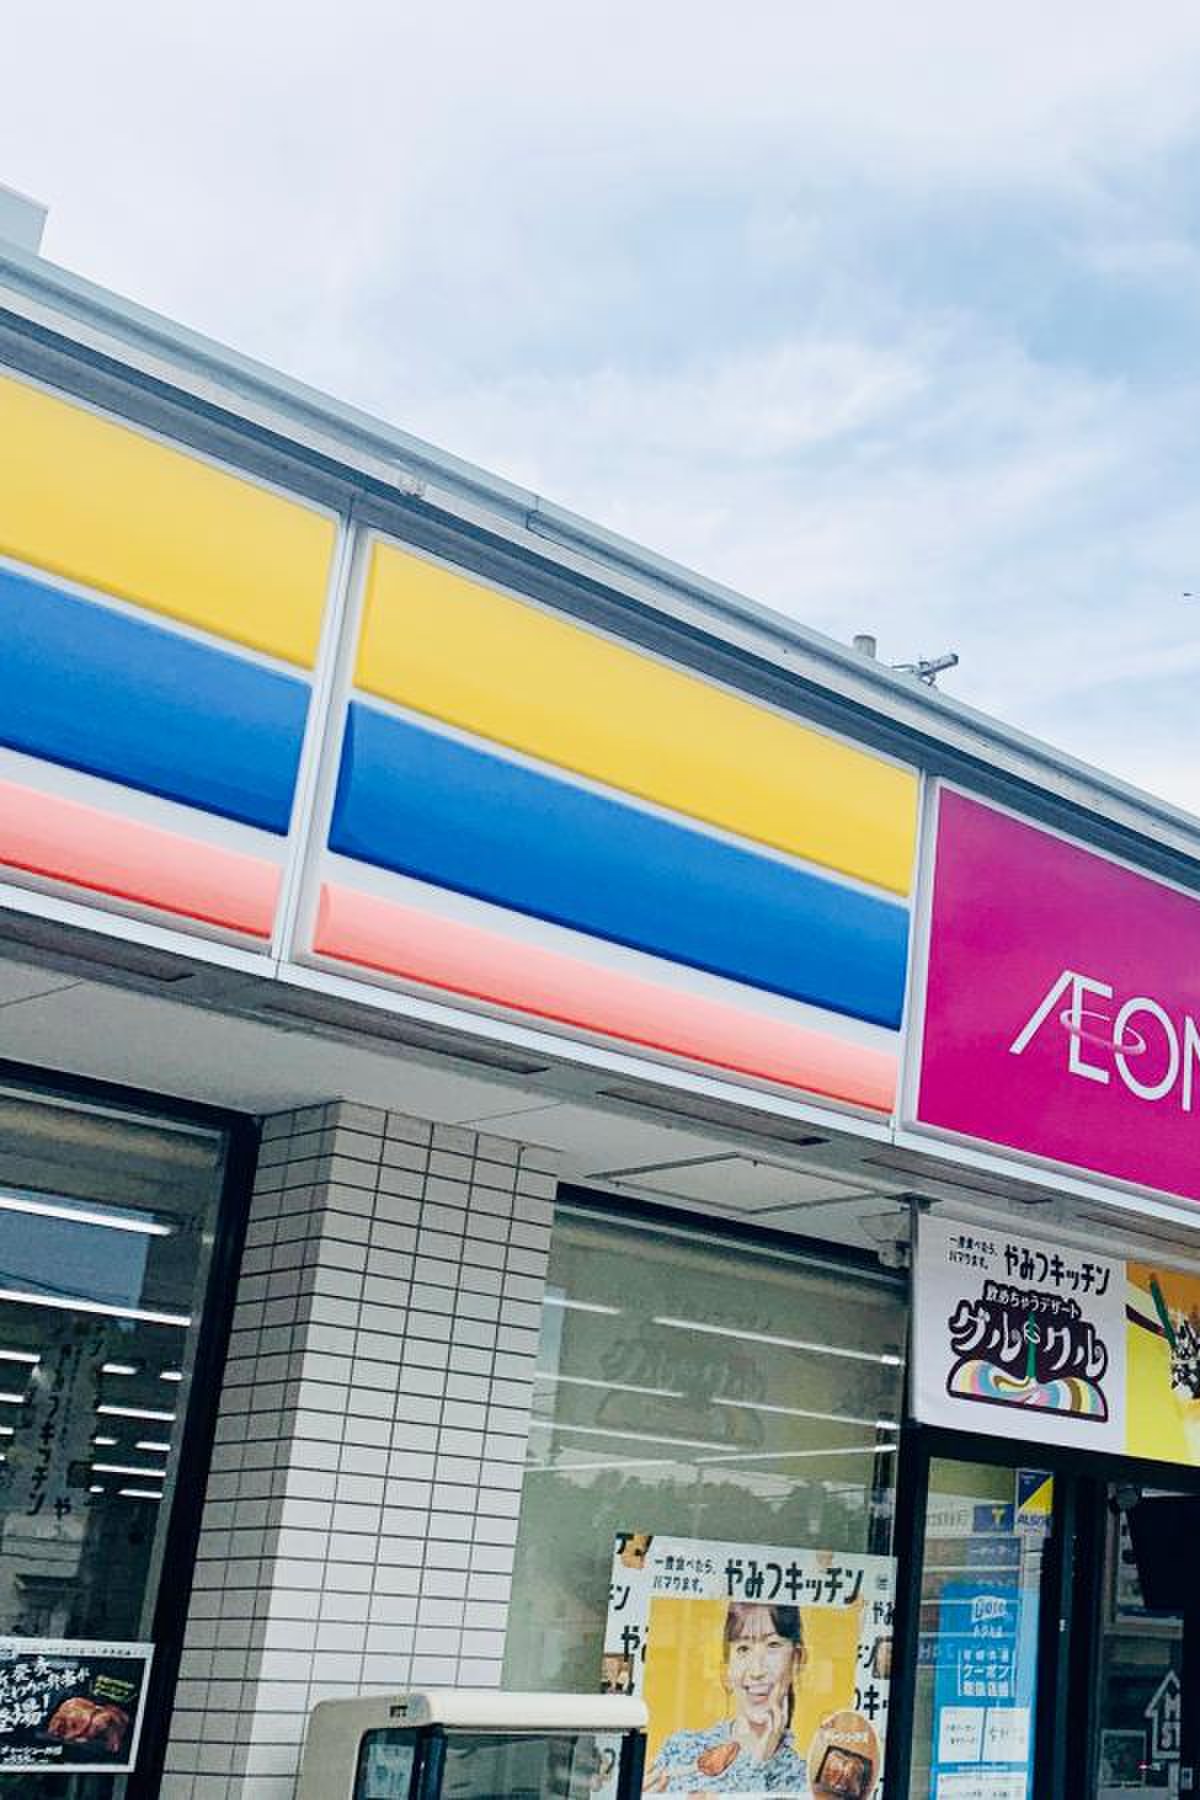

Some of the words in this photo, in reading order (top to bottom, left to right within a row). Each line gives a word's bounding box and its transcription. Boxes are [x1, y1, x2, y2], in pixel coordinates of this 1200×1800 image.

[1004, 1243, 1111, 1296] やみつキッチン
[724, 1557, 865, 1604] やみつキッチン
